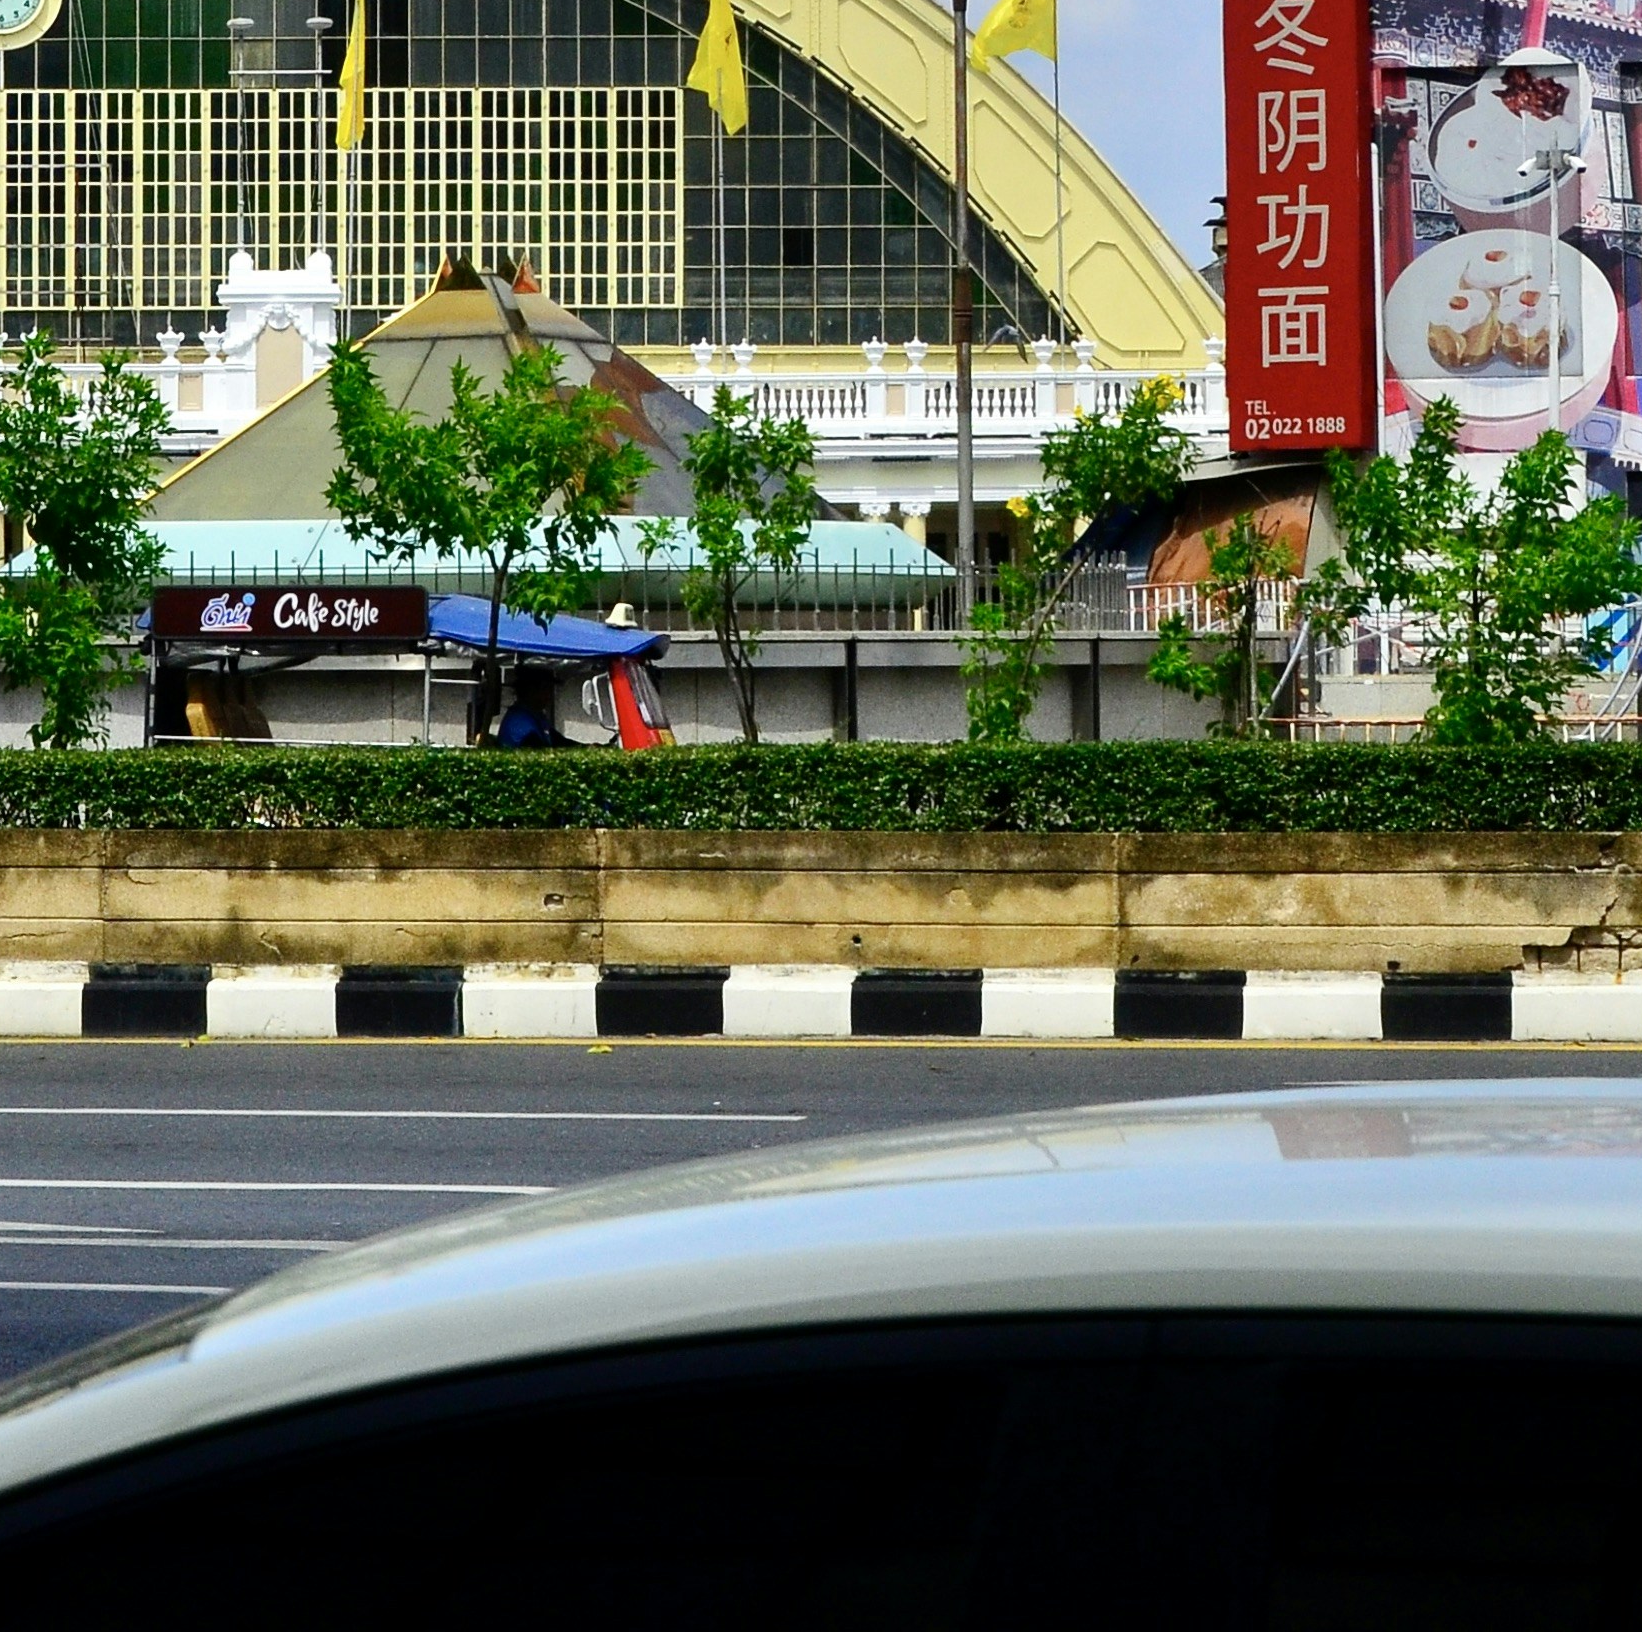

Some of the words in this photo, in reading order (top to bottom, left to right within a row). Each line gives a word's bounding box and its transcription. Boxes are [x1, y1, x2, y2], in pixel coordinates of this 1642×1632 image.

[1244, 399, 1277, 416] TEL.
[1245, 418, 1271, 440] 02
[1272, 417, 1303, 435] 022
[1306, 416, 1347, 434] 1888
[273, 592, 329, 633] Café
[330, 597, 380, 633] Style
